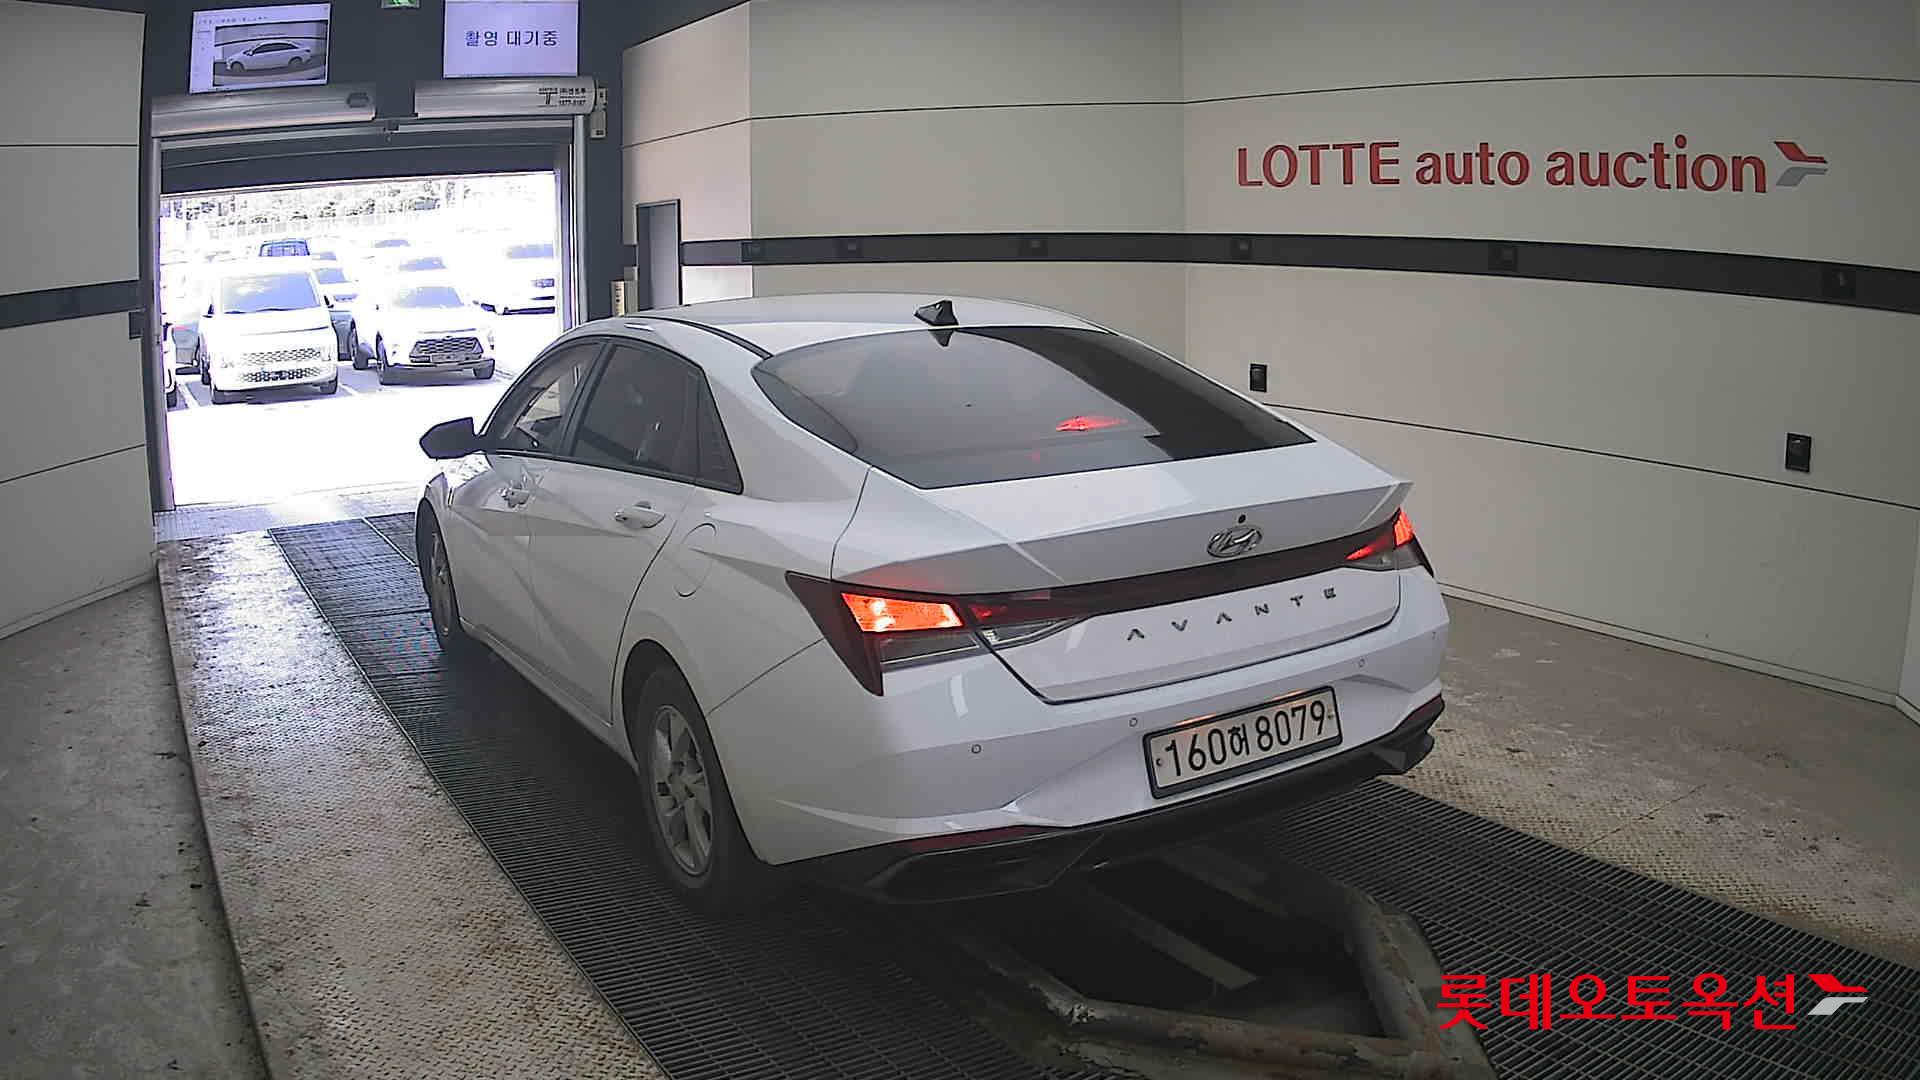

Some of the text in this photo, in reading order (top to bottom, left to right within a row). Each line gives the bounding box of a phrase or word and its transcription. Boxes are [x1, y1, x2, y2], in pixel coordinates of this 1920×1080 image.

[506, 29, 558, 47] 대기중
[1236, 135, 1768, 193] LOTTE auto auction
[1126, 587, 1337, 641] AVANTE
